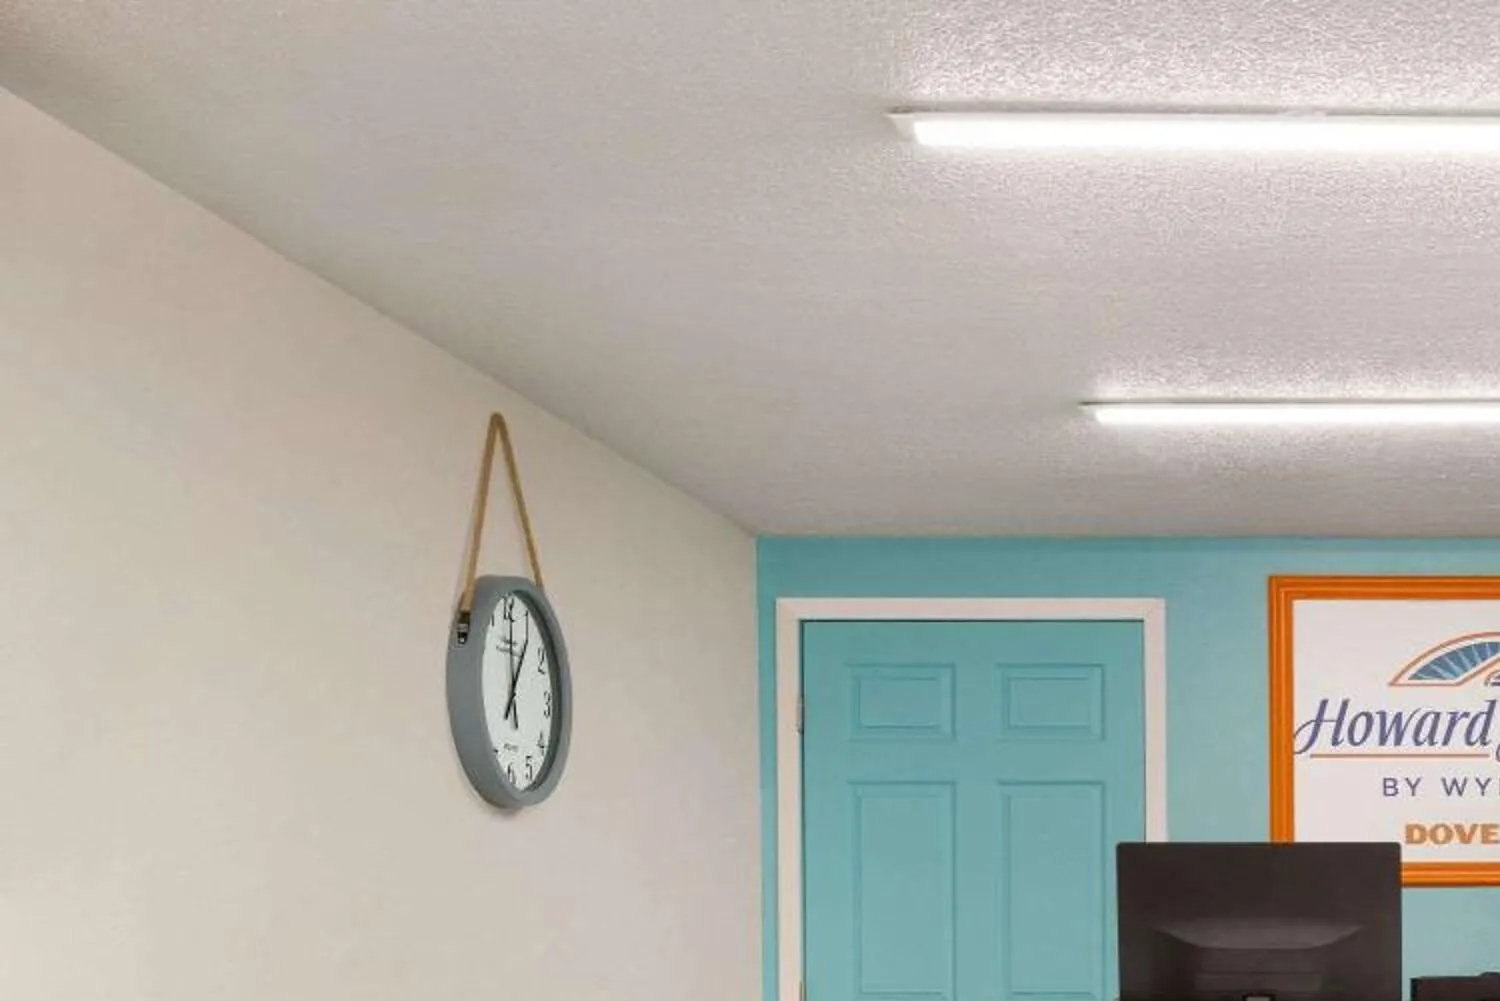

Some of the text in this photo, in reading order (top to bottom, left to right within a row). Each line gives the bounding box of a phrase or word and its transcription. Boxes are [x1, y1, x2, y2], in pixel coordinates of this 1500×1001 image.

[543, 691, 551, 719] 3
[1293, 697, 1498, 754] Howard
[1382, 777, 1421, 797] BY
